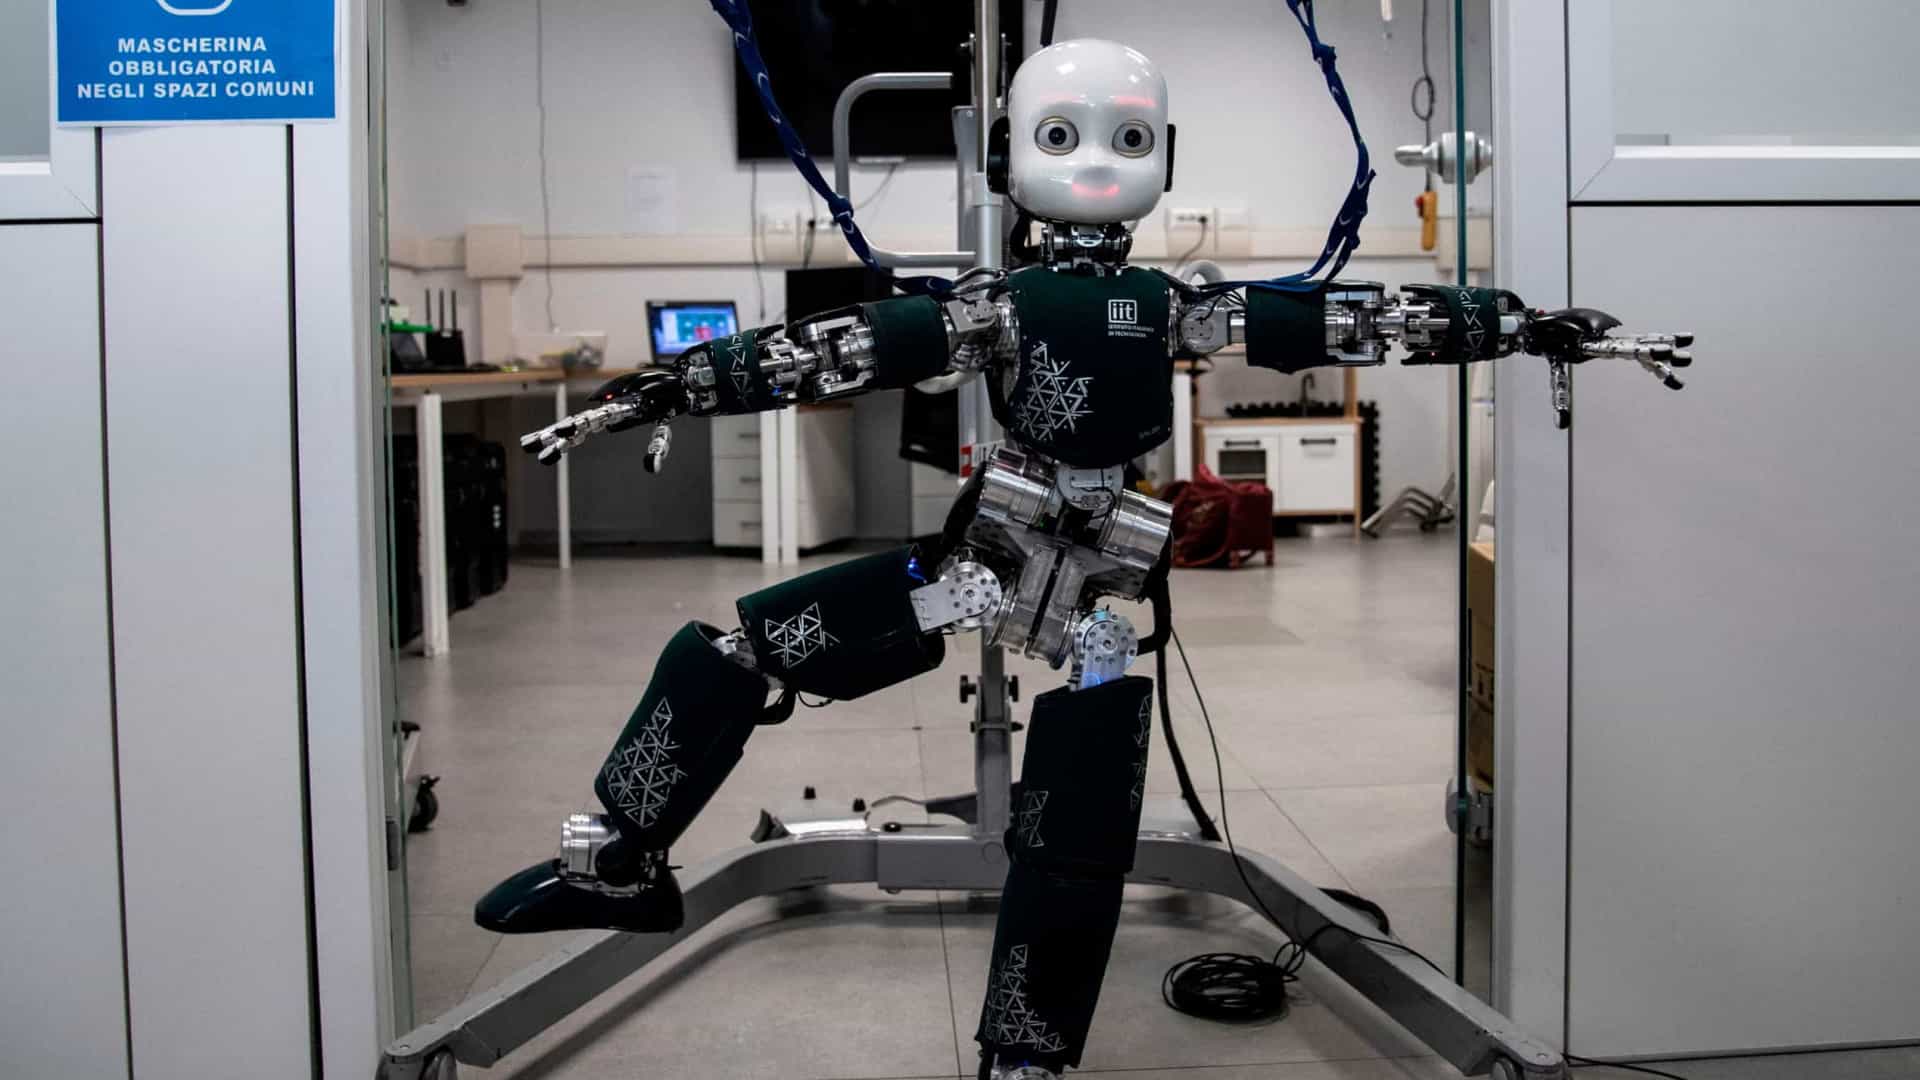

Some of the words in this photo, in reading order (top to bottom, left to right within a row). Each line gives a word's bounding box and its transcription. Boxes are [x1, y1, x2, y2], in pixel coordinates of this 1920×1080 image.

[117, 36, 267, 53] MASCHERINA
[108, 59, 276, 76] OBBLIGATORIA
[77, 83, 145, 98] NEGLI
[153, 82, 217, 98] SPAZI
[225, 81, 315, 97] COMUNI
[1112, 302, 1134, 321] iit
